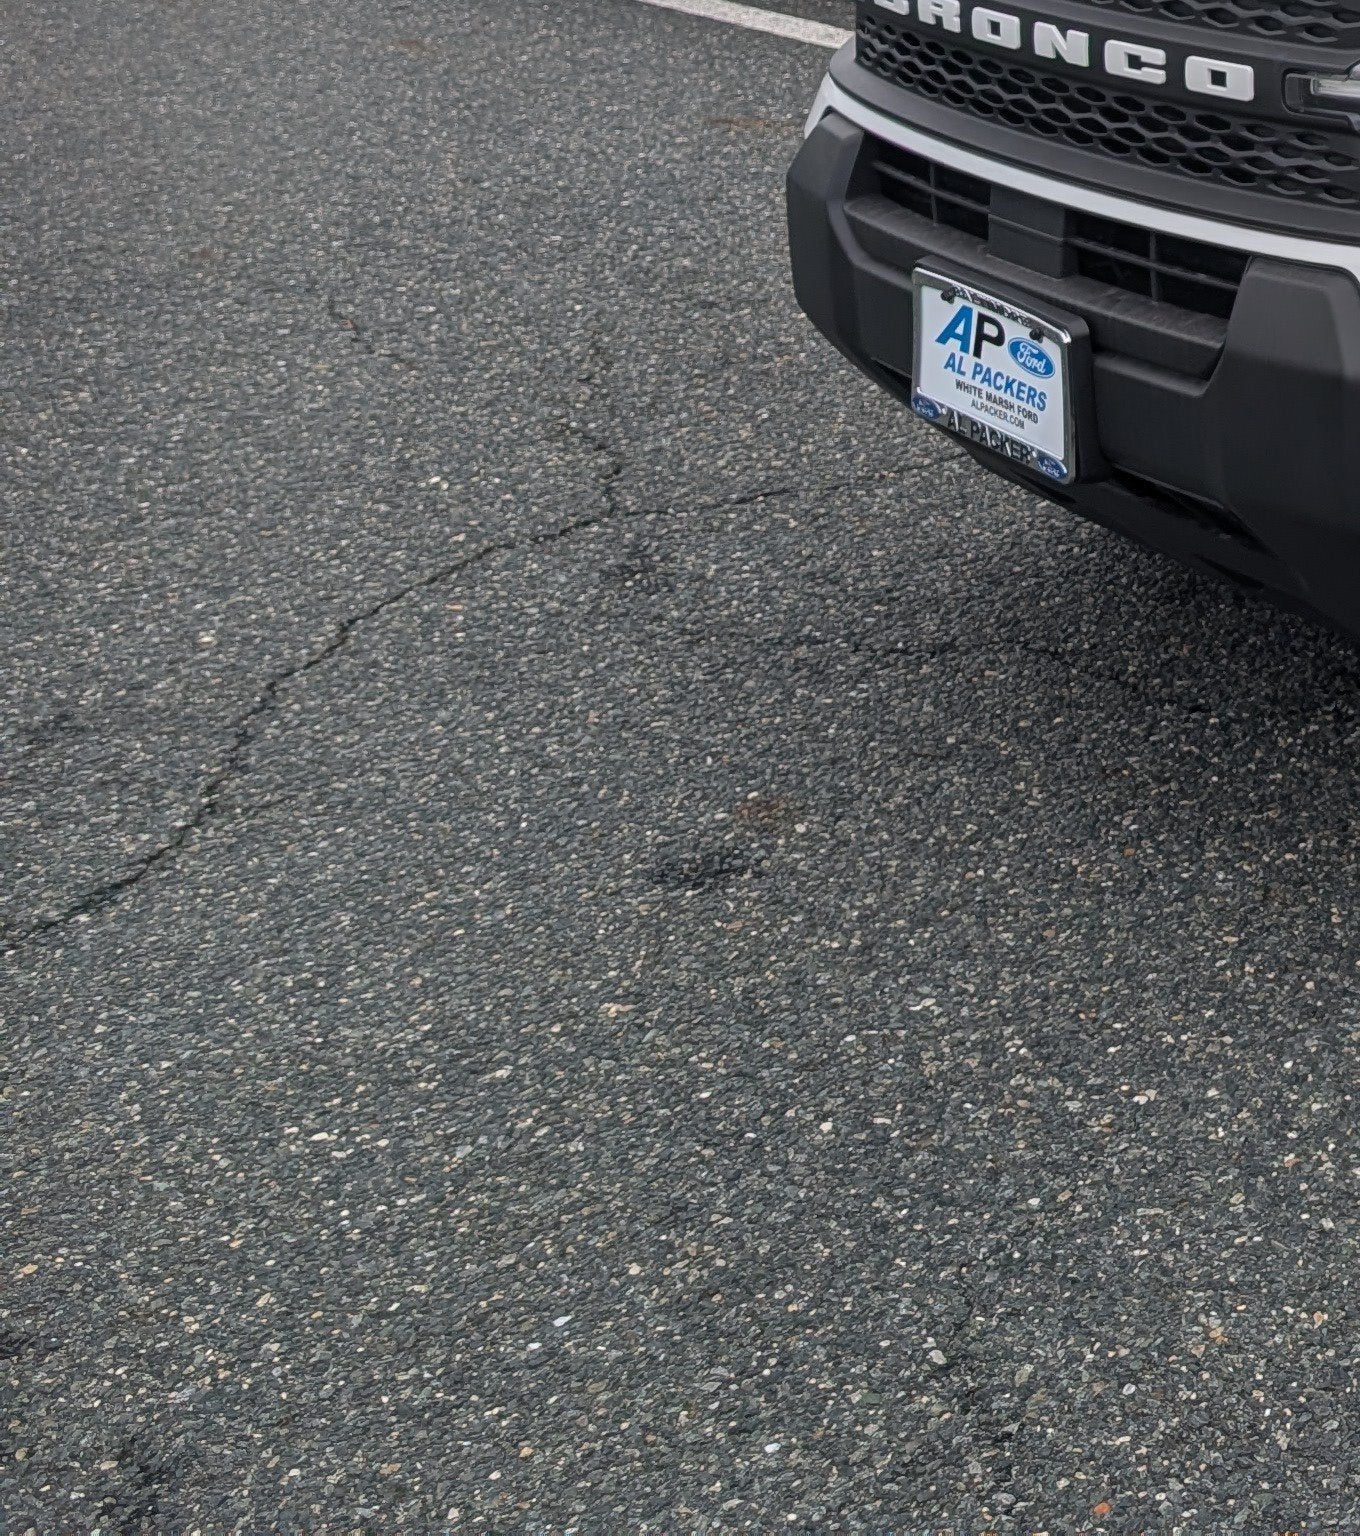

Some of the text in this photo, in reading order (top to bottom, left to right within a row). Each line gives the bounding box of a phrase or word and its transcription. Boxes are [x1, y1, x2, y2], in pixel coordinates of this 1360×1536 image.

[935, 304, 1006, 359] AP
[1016, 341, 1047, 375] Ford
[944, 352, 1048, 412] AL PACKERS
[955, 378, 1039, 424] WHITE MARSH FORD
[971, 399, 1025, 430] ALPACKER.COM
